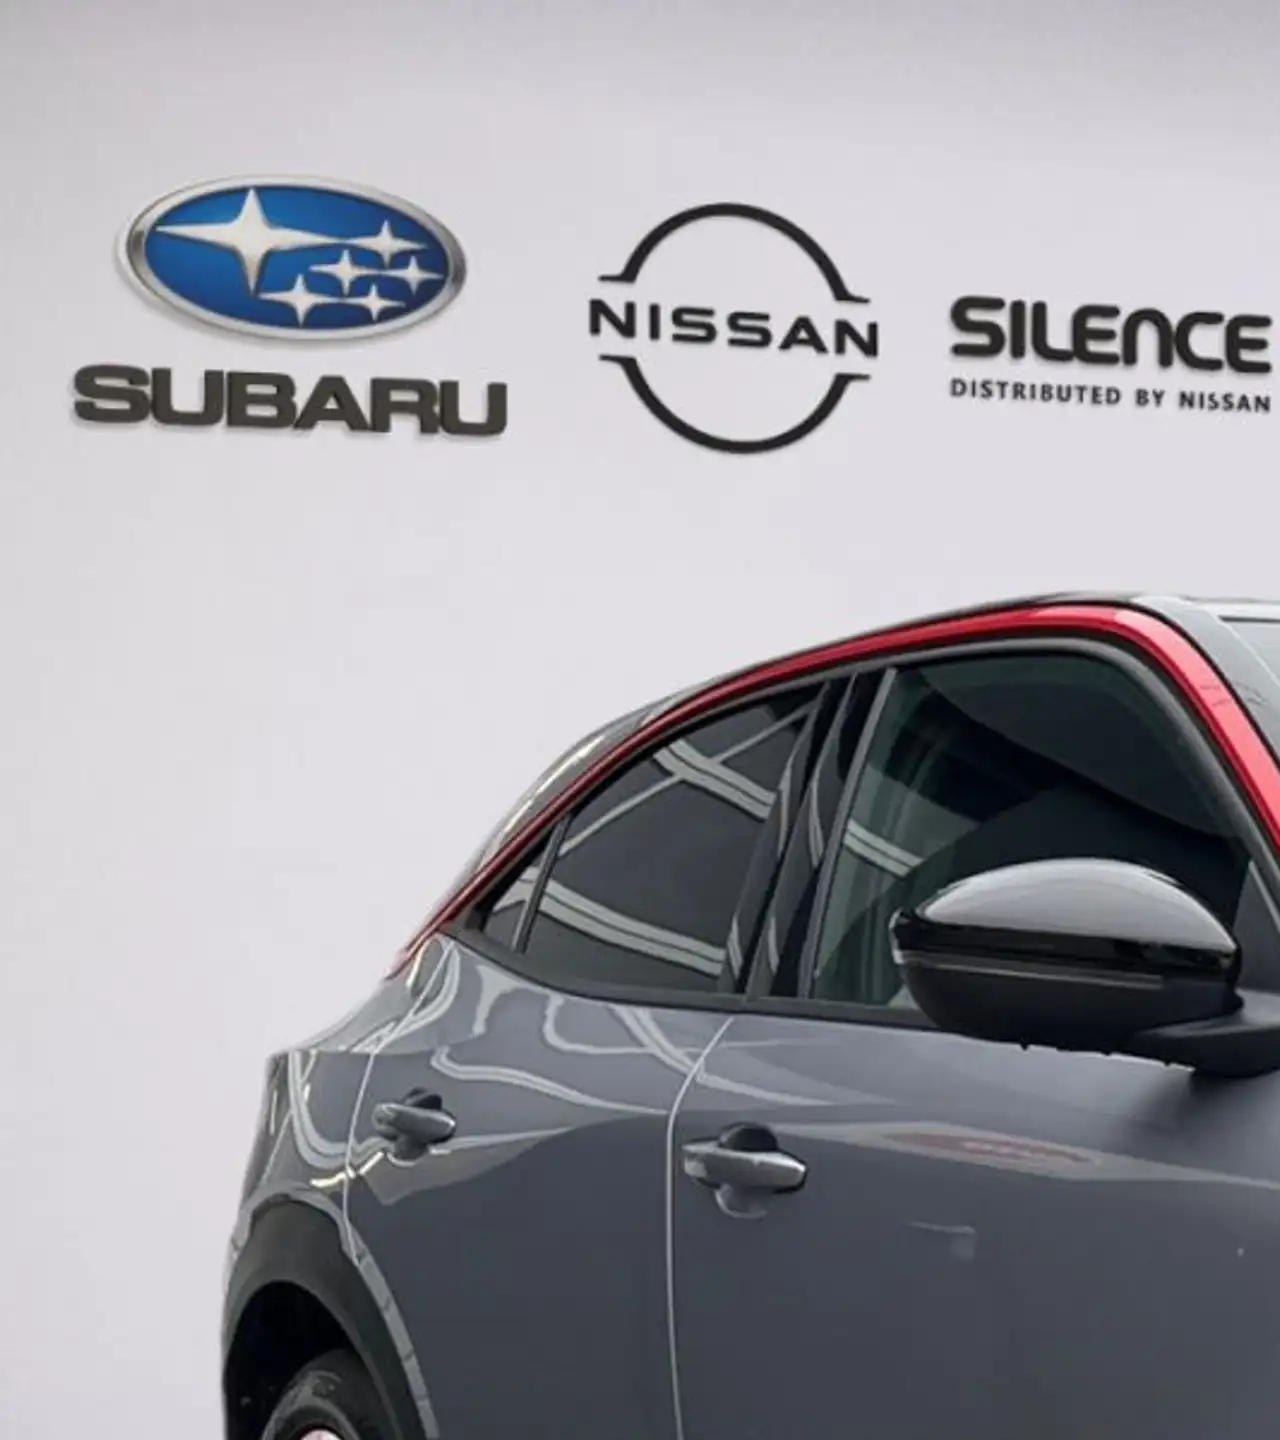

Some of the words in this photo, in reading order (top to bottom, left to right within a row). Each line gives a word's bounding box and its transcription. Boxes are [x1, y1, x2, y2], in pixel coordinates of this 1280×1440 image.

[588, 298, 879, 358] NISSAN
[949, 295, 1273, 374] SILENCE
[72, 363, 509, 438] SUBARU
[949, 377, 1122, 406] DISTRIBUTED
[1134, 387, 1166, 407] BY
[1178, 390, 1272, 413] NISSAN
